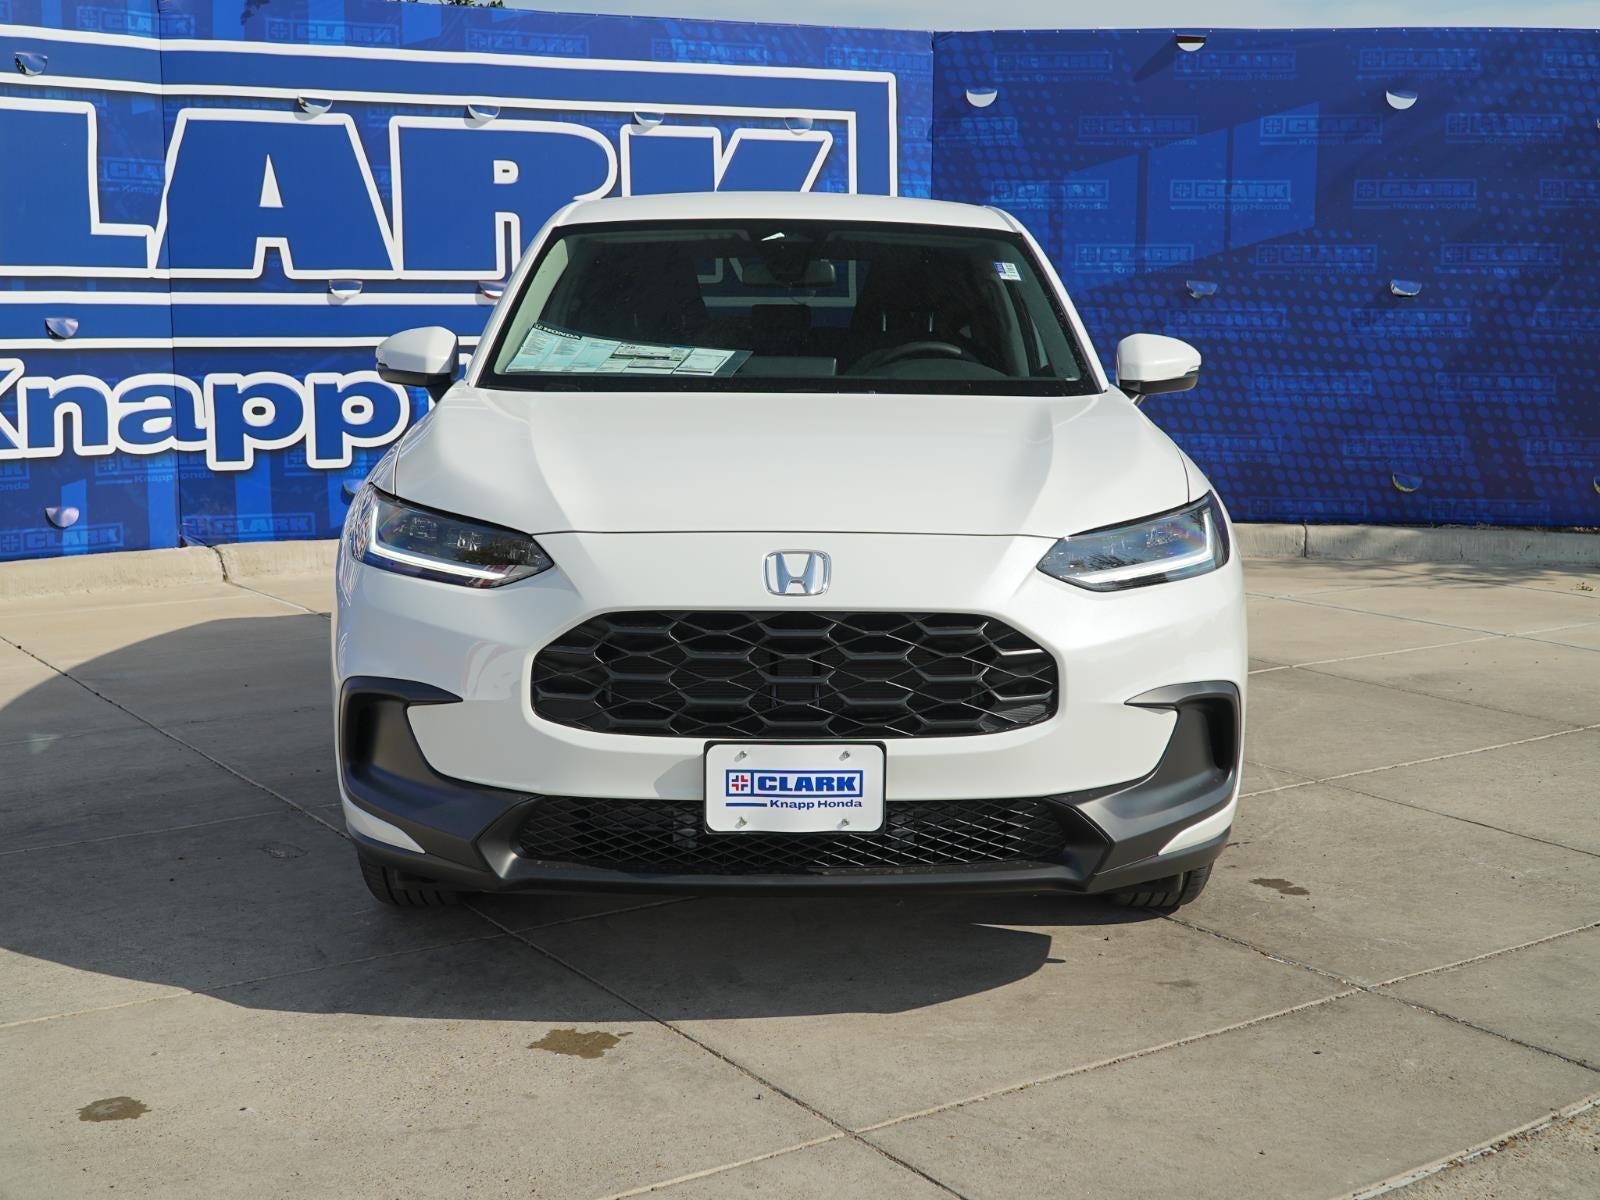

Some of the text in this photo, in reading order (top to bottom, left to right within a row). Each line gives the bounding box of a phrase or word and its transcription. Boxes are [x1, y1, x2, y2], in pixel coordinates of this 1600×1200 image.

[109, 161, 162, 180] CLA
[0, 357, 411, 470] napp
[757, 776, 857, 792] CLARK
[769, 799, 863, 811] Knapp Honda
